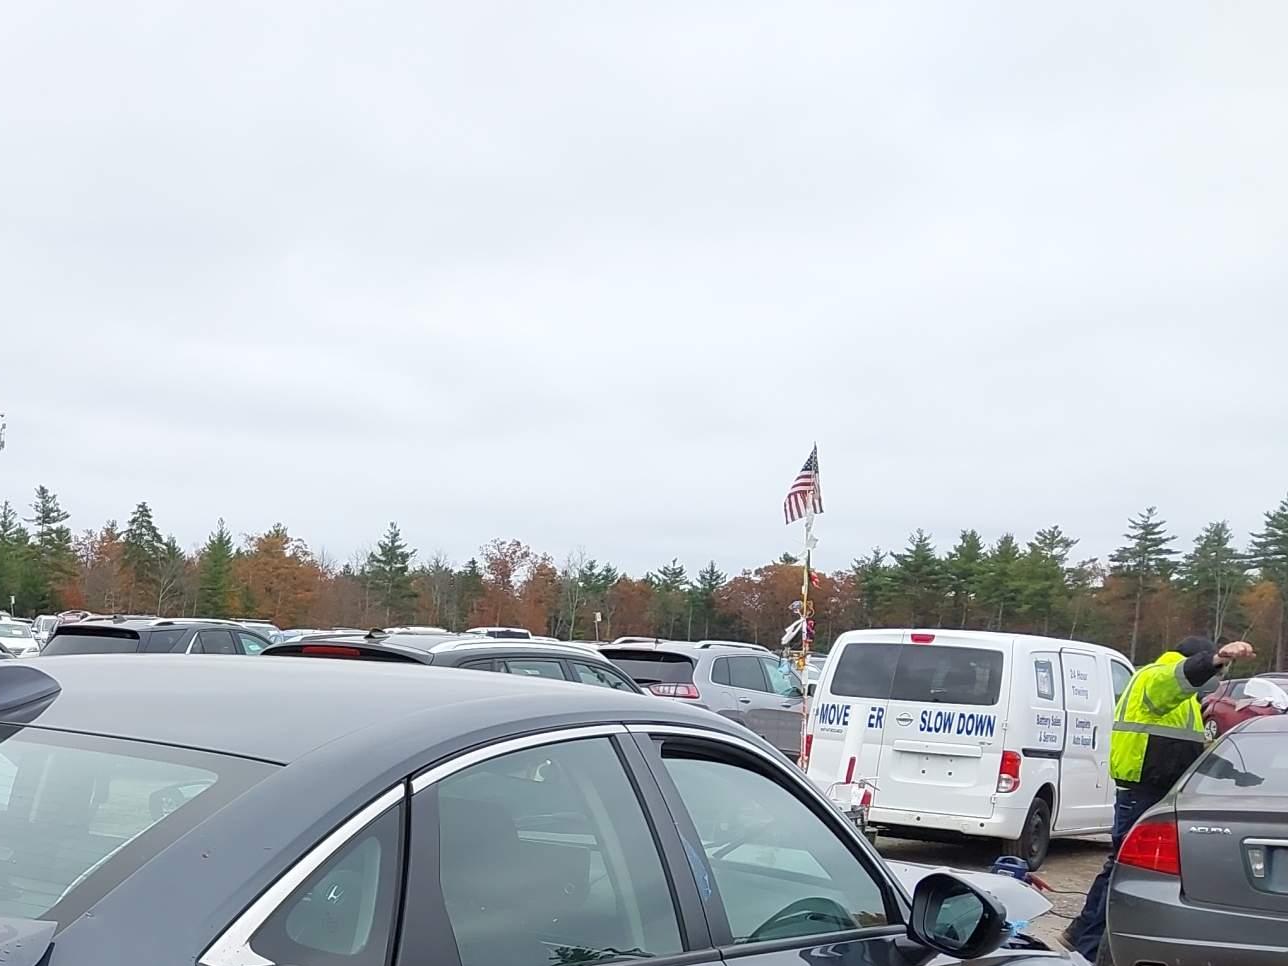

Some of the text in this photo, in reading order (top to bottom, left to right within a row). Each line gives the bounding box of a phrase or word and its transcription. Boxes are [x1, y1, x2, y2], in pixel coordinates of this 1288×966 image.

[819, 703, 996, 738] MOVE ER SLOW DOWN
[1190, 826, 1232, 835] ACURA
